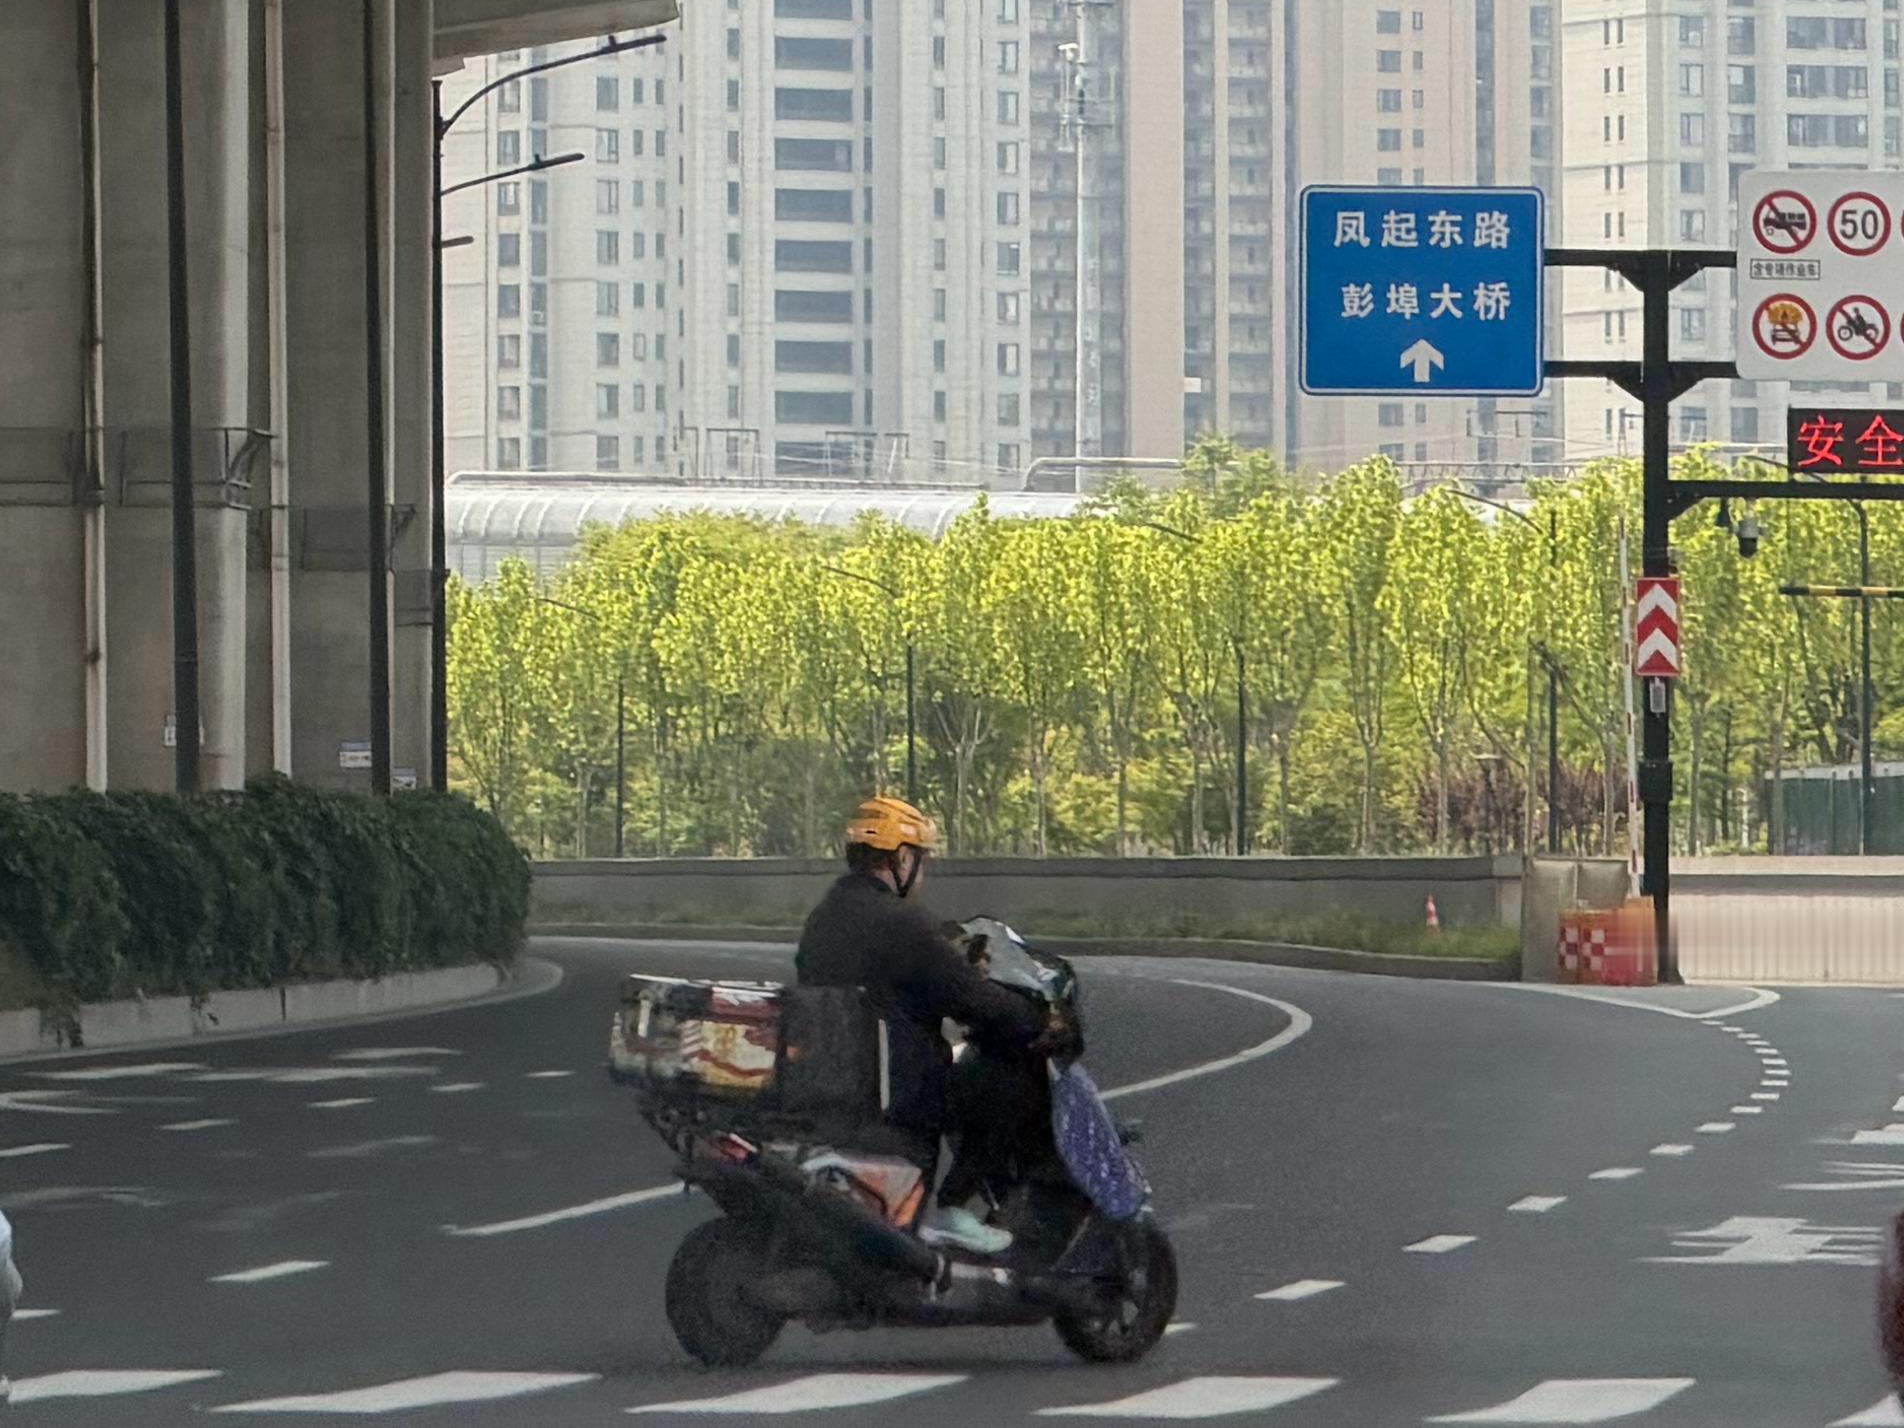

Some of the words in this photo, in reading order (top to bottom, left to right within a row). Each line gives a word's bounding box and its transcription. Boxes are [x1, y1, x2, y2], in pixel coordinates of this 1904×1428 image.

[1333, 209, 1511, 249] 凤起东路
[1840, 209, 1879, 240] 50
[1341, 281, 1511, 320] 彭埠大桥
